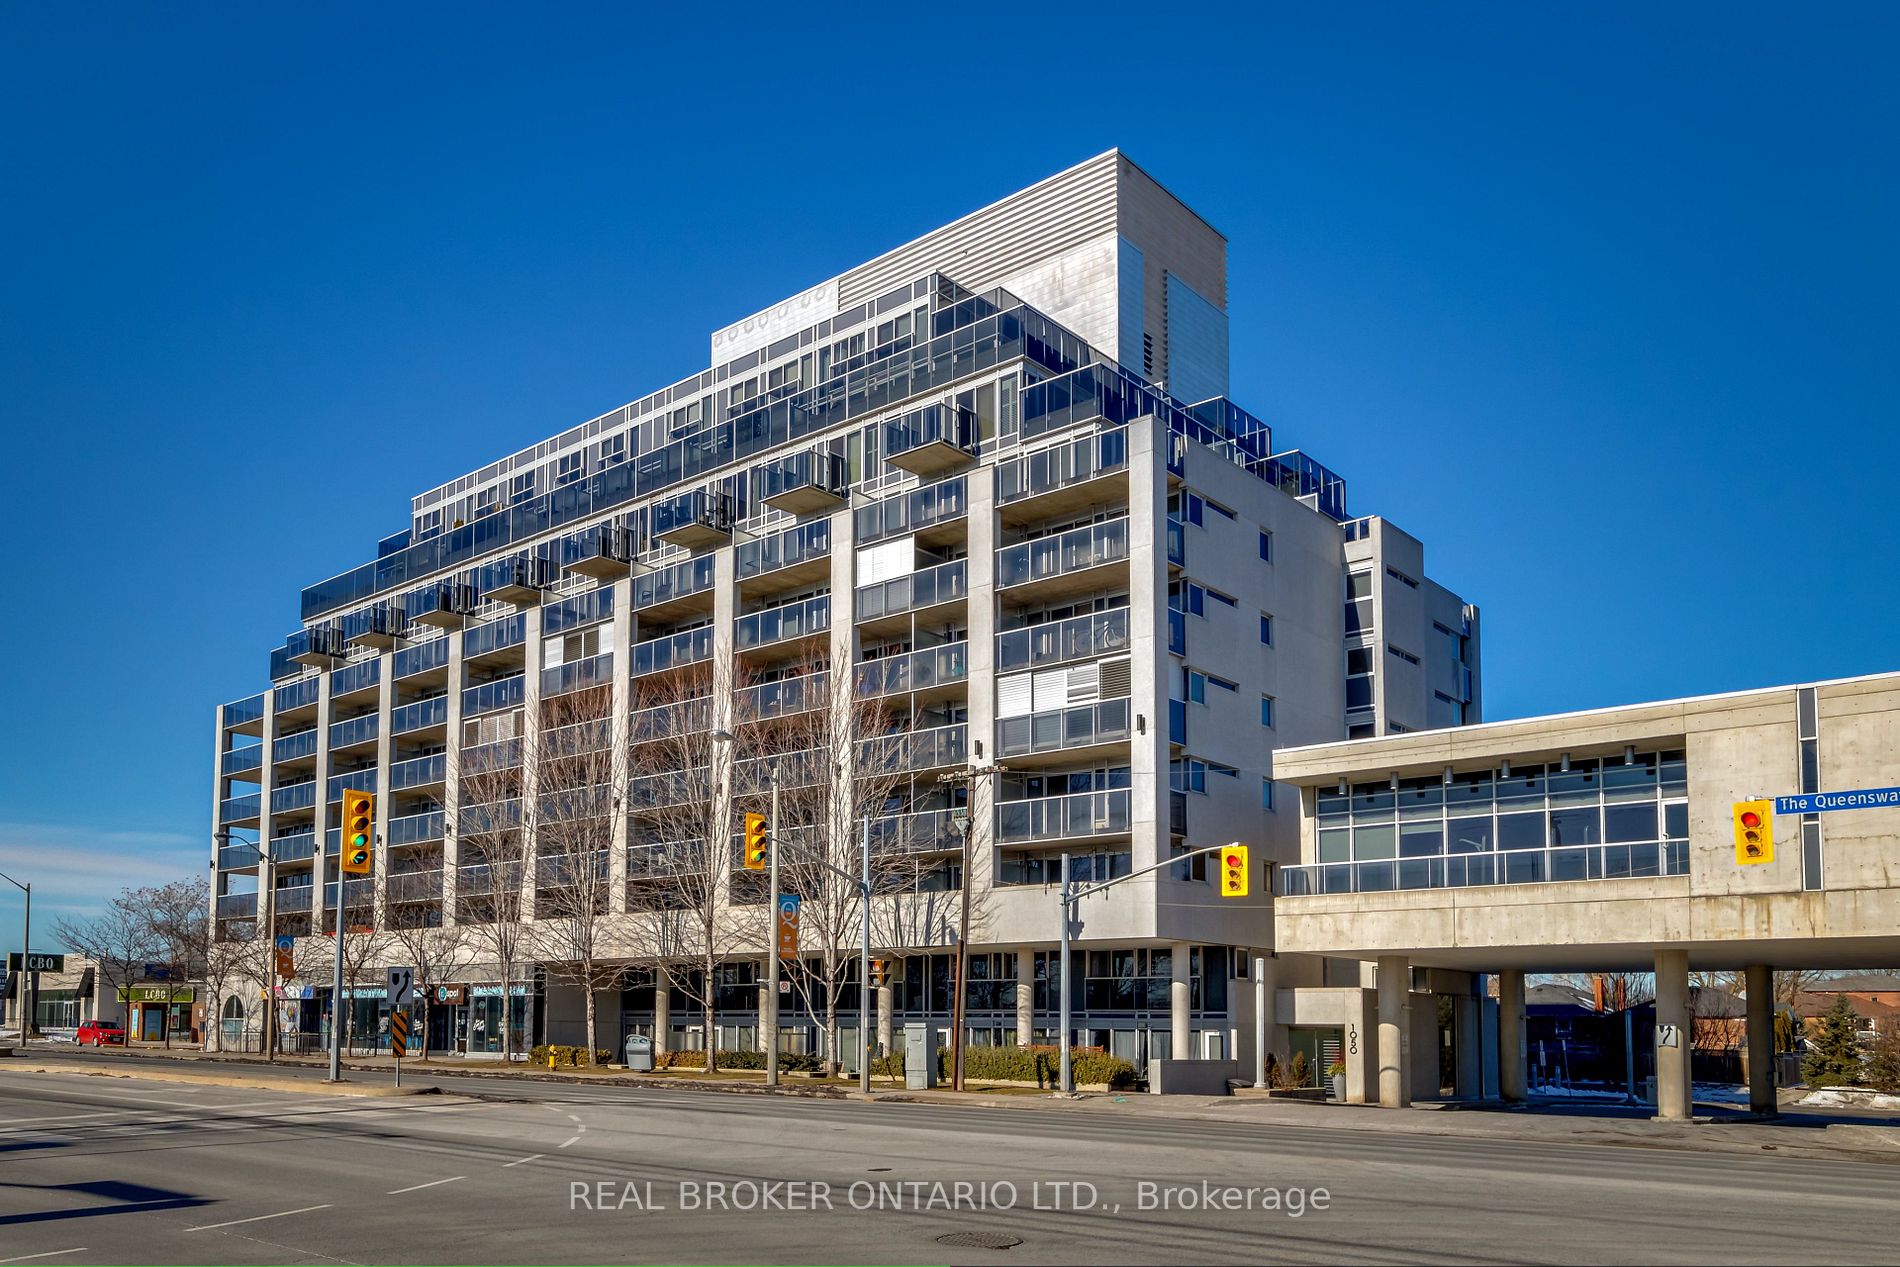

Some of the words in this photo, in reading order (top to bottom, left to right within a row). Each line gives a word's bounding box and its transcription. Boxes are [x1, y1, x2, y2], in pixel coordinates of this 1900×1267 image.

[1780, 798, 1807, 810] The
[1815, 791, 1900, 808] Queenswa
[781, 901, 798, 929] Q
